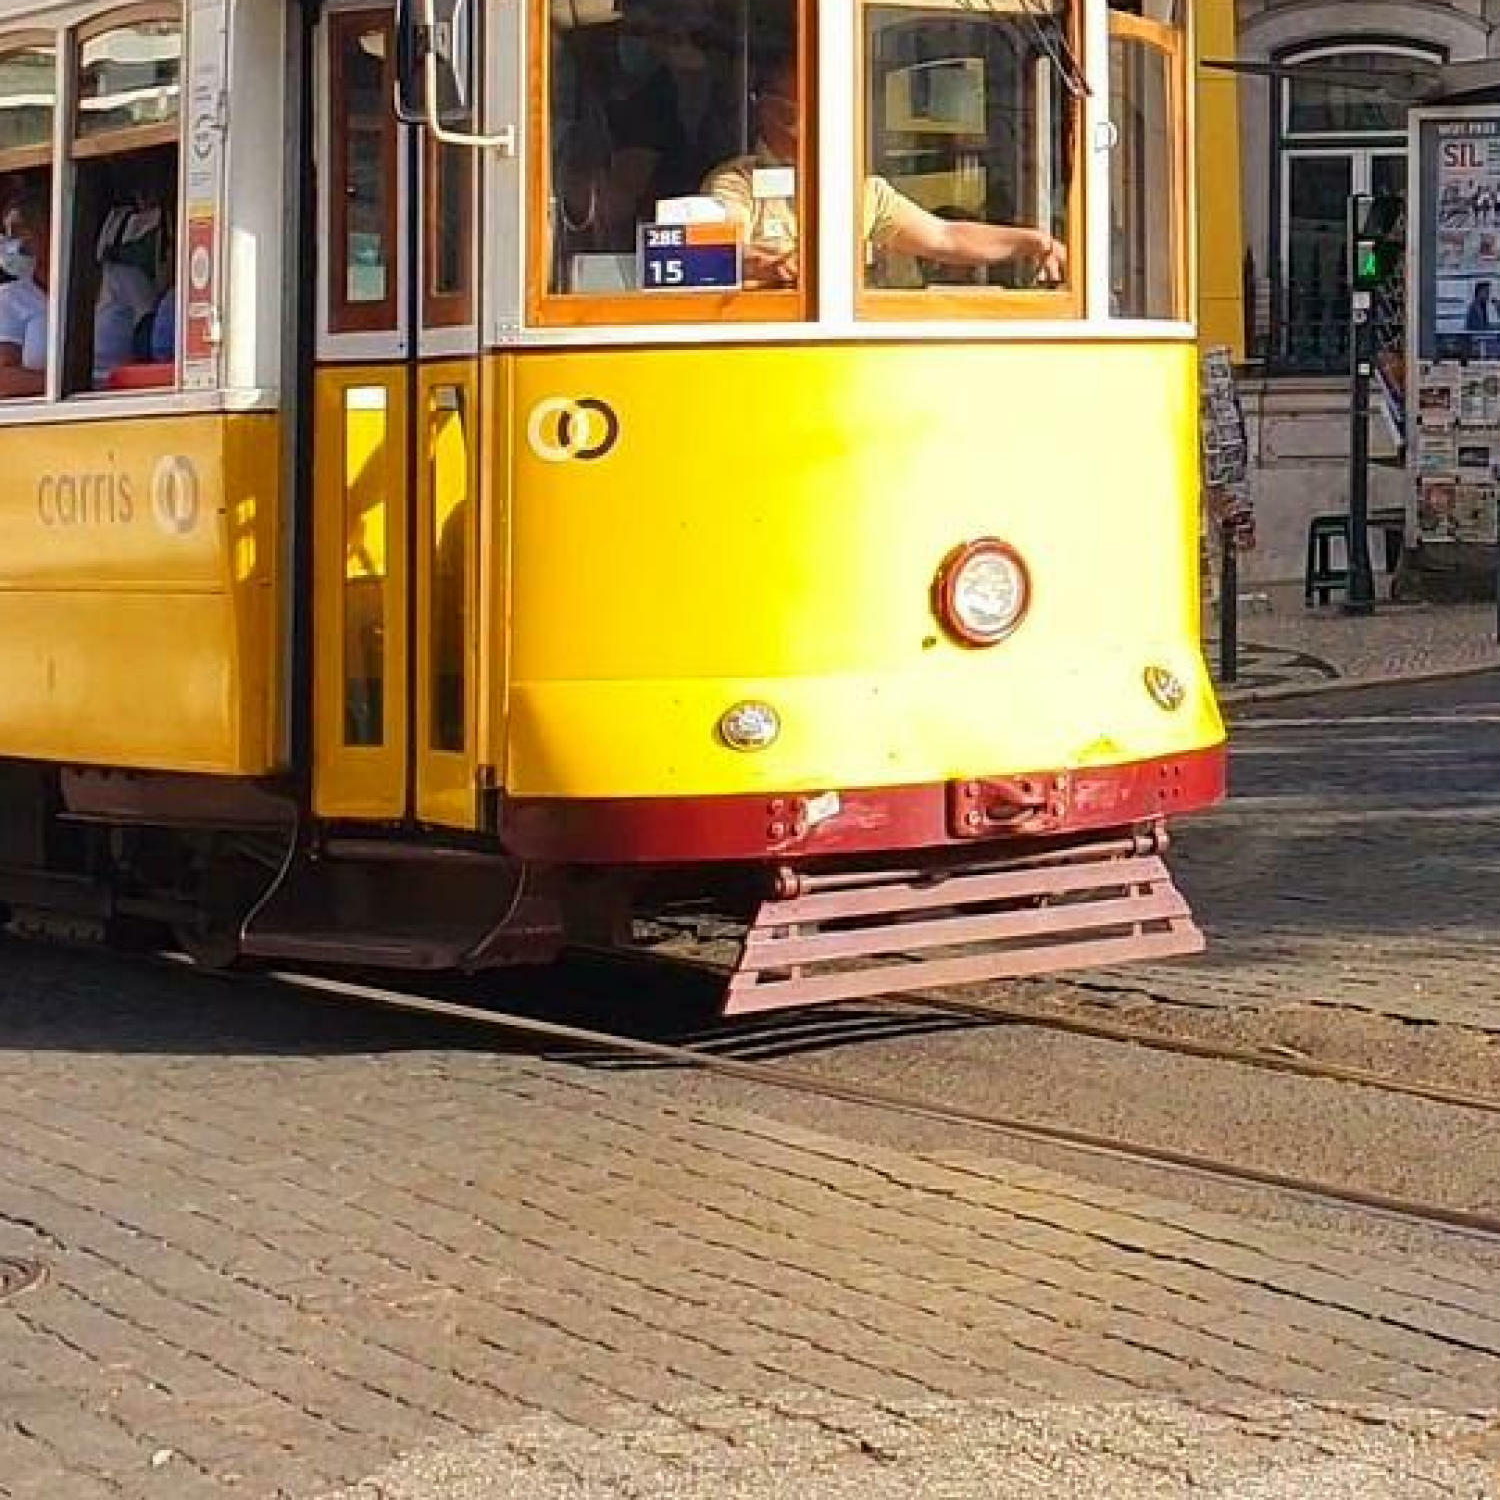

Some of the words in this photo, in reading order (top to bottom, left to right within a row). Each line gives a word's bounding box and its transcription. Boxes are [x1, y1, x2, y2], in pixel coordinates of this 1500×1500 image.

[1443, 143, 1484, 168] SIL
[650, 260, 684, 283] 15
[38, 449, 133, 526] carris
